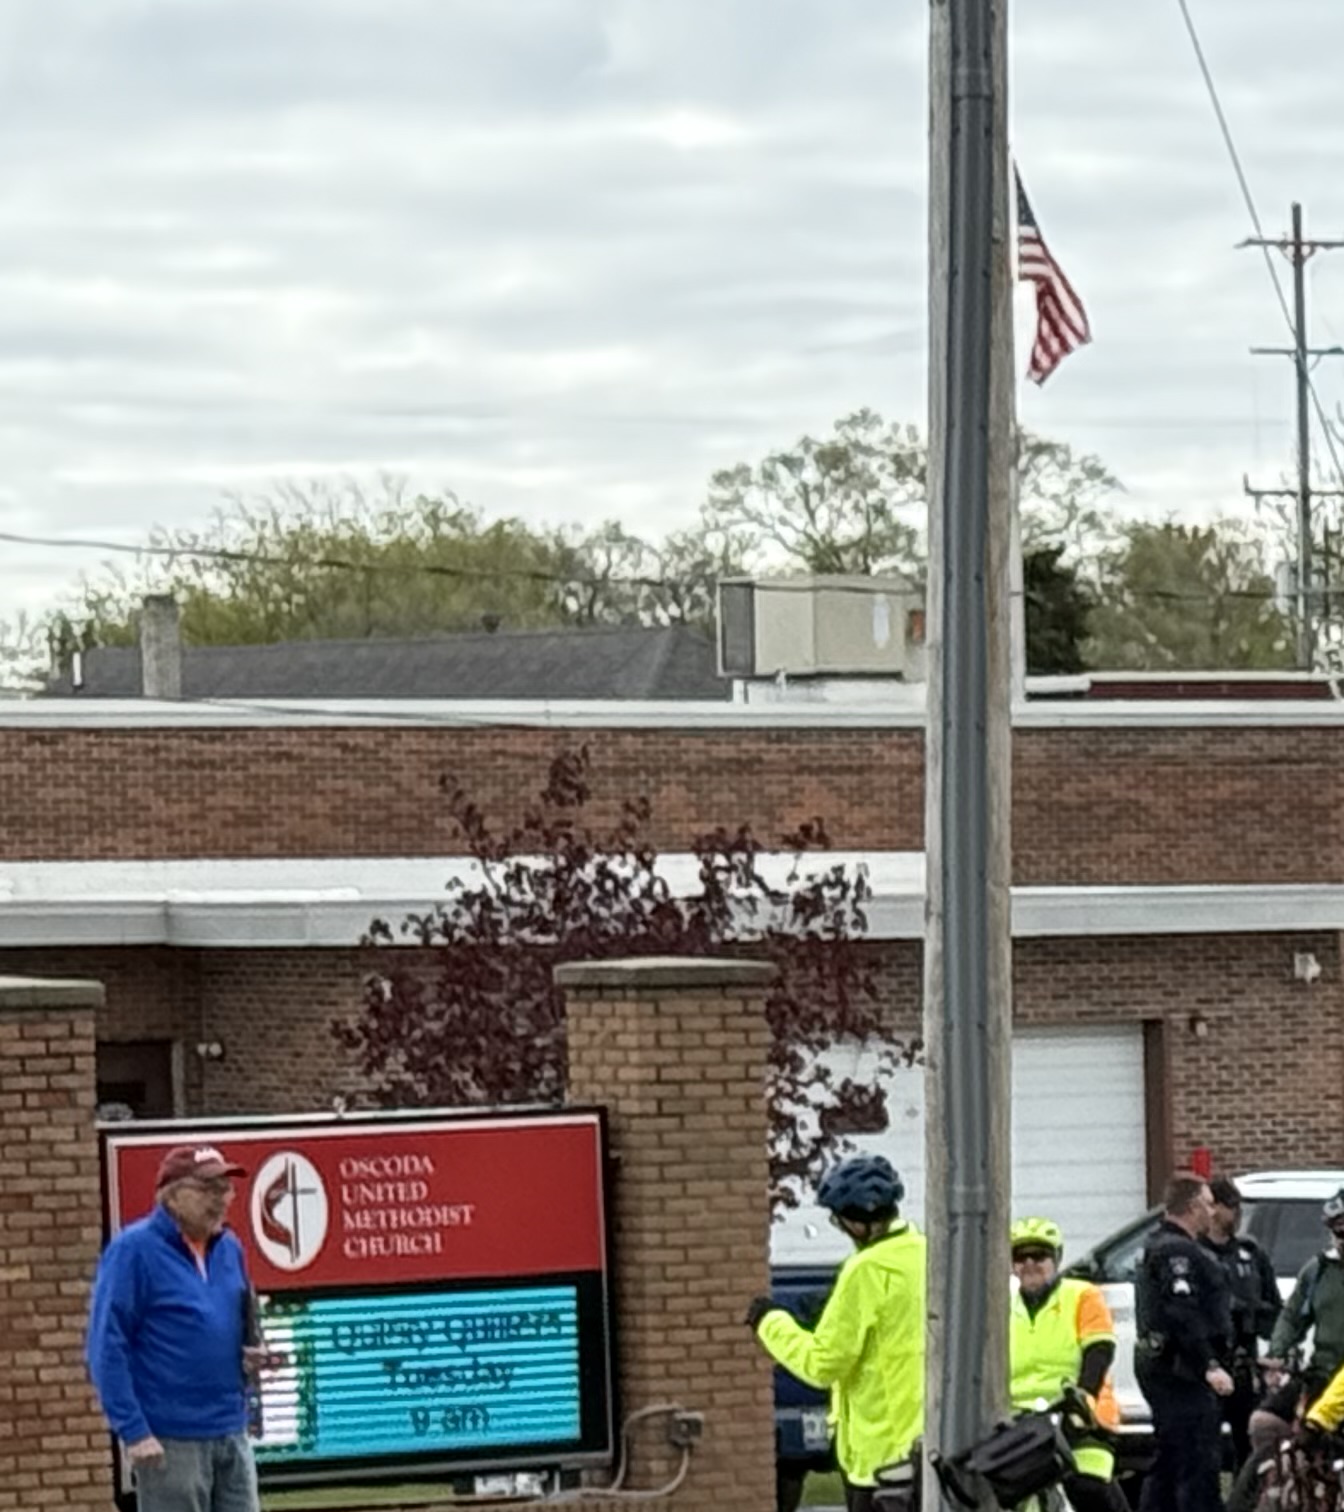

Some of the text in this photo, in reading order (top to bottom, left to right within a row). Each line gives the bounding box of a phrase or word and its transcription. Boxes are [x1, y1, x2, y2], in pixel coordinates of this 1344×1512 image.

[339, 1154, 435, 1179] OSCODA
[341, 1180, 429, 1206] UNITED
[342, 1204, 475, 1232] METHODIST
[343, 1231, 443, 1259] CHURCH
[381, 1356, 512, 1393] Tuesday
